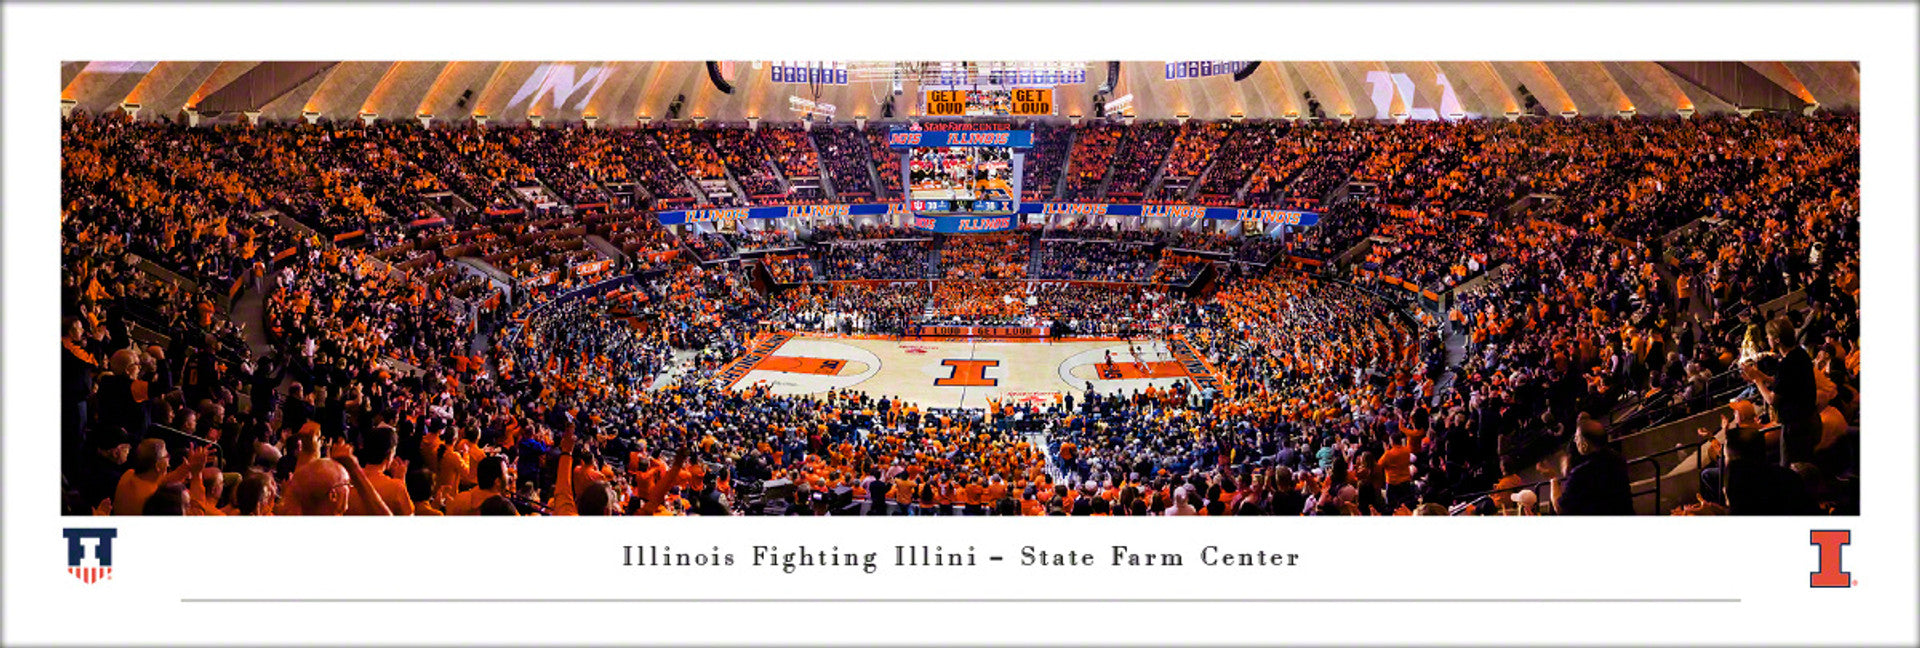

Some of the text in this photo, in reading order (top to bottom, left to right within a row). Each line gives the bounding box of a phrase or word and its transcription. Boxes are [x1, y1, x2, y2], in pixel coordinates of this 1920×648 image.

[931, 90, 959, 102] GET
[1016, 90, 1045, 102] GET
[927, 103, 963, 115] LOUD
[1013, 103, 1049, 114] LOUD
[946, 132, 1010, 145] ILLINOIS
[685, 209, 750, 223] ILLINOIS
[787, 204, 850, 217] ILLINOIS
[1042, 203, 1302, 224] ILLINOIS ILLINOIS ILLINOIS
[958, 217, 1011, 231] ILLINOIS
